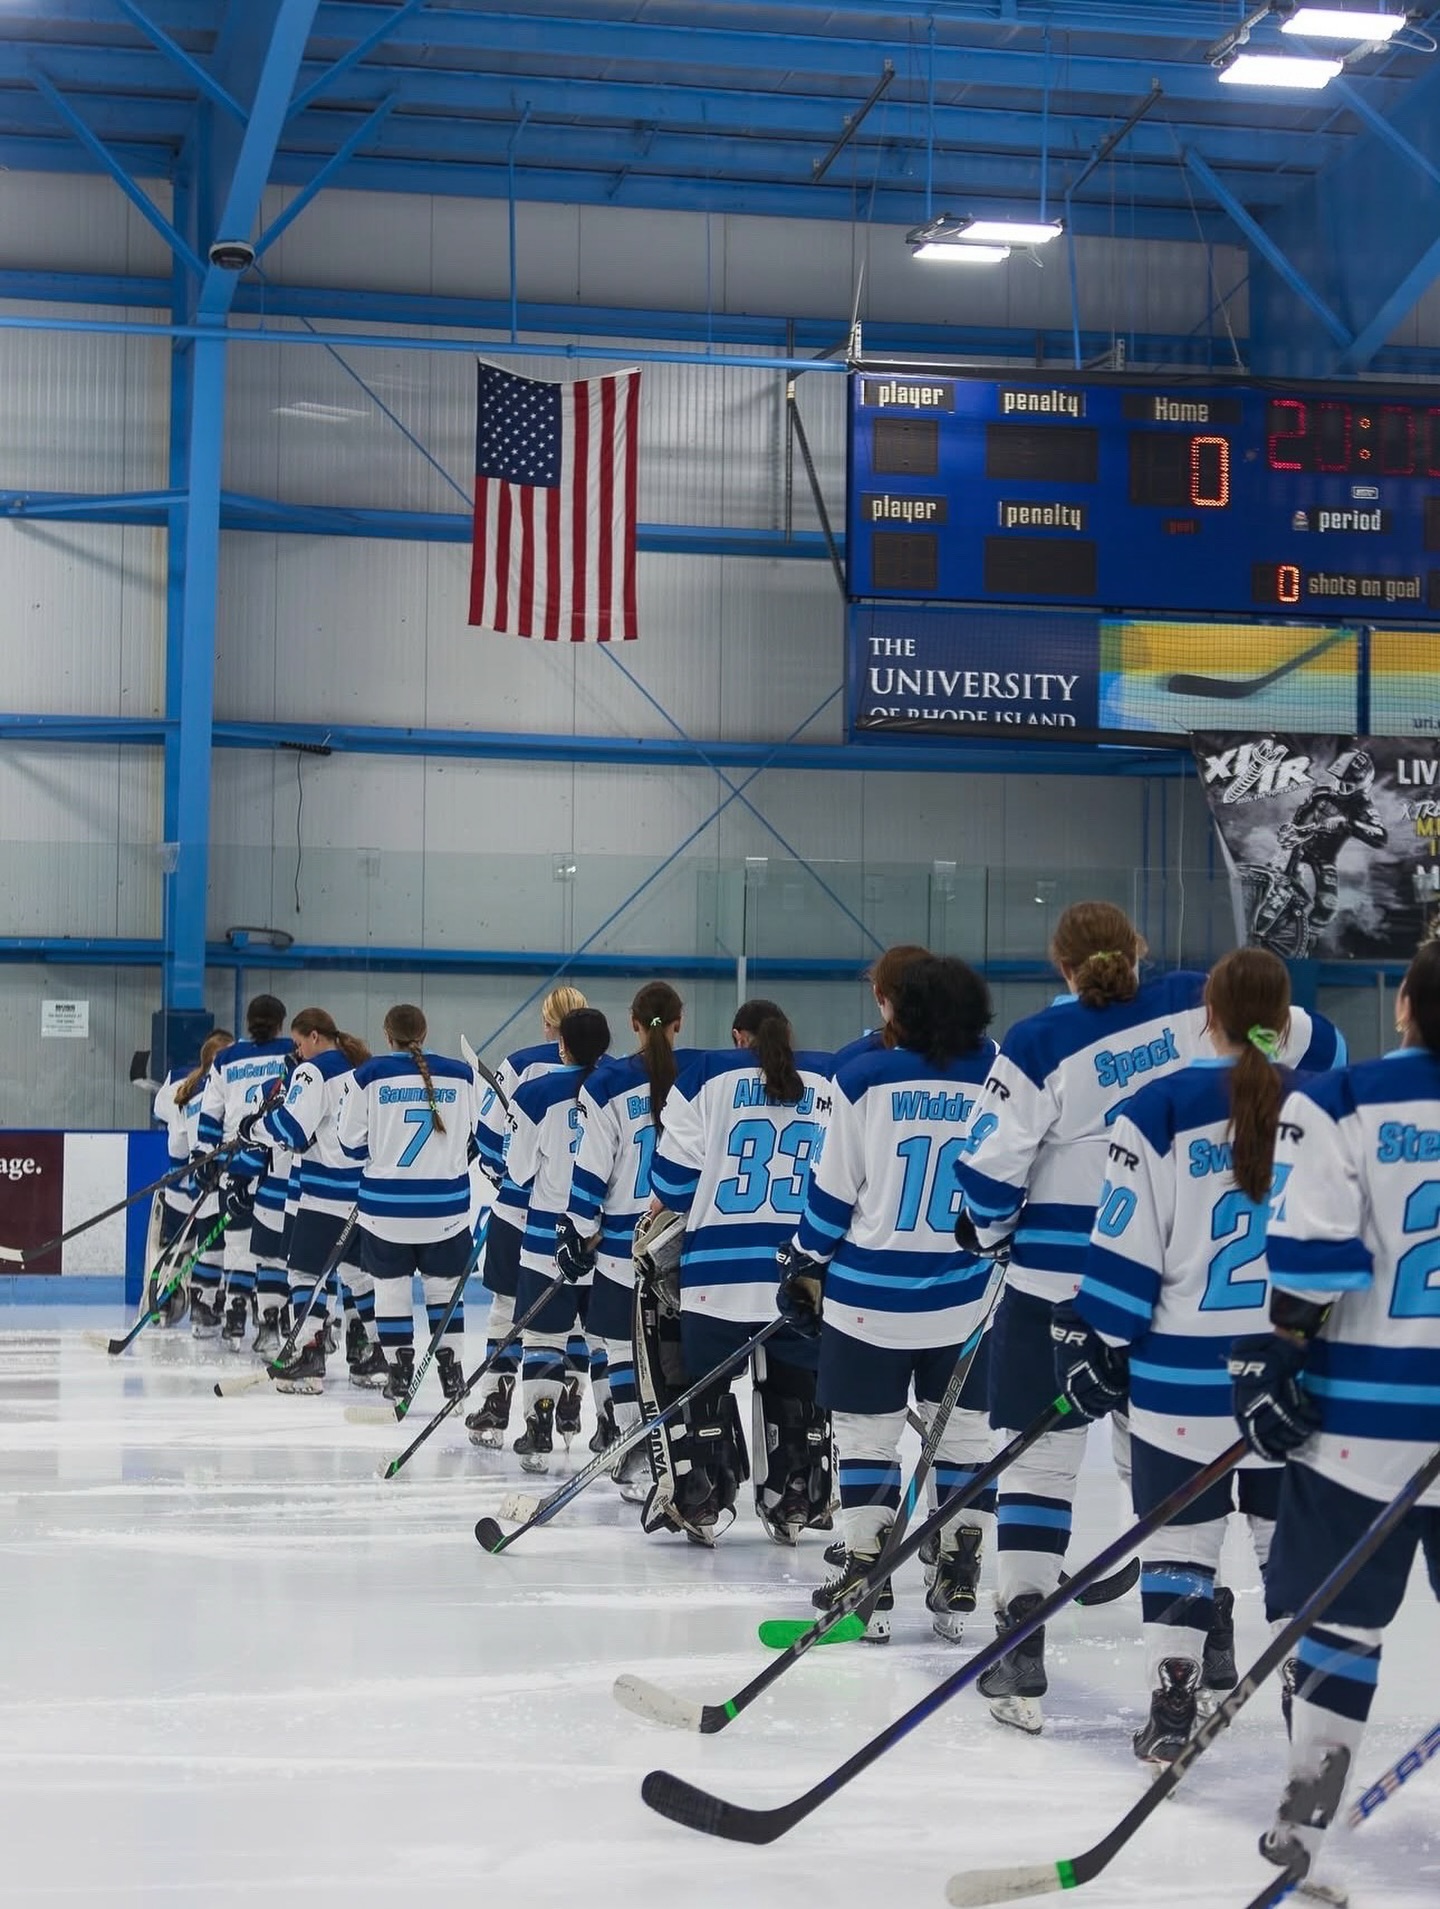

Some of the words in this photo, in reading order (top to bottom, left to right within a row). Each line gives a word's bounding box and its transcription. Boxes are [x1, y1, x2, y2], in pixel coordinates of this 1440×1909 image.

[878, 381, 944, 409] player
[1004, 390, 1080, 417] penalty
[1154, 397, 1209, 422] Home
[1189, 436, 1230, 507] 0
[872, 495, 937, 523] player
[1007, 503, 1082, 530] penalty
[1318, 509, 1382, 532] period
[1278, 565, 1300, 602] 0
[1308, 573, 1357, 596] shots
[1361, 579, 1382, 597] on
[1385, 577, 1421, 601] goal
[868, 637, 916, 657] THE
[868, 668, 1080, 701] UNIVERSITY
[1398, 759, 1440, 785] LIV
[1094, 1028, 1181, 1088] Spack
[397, 1109, 435, 1167] 7
